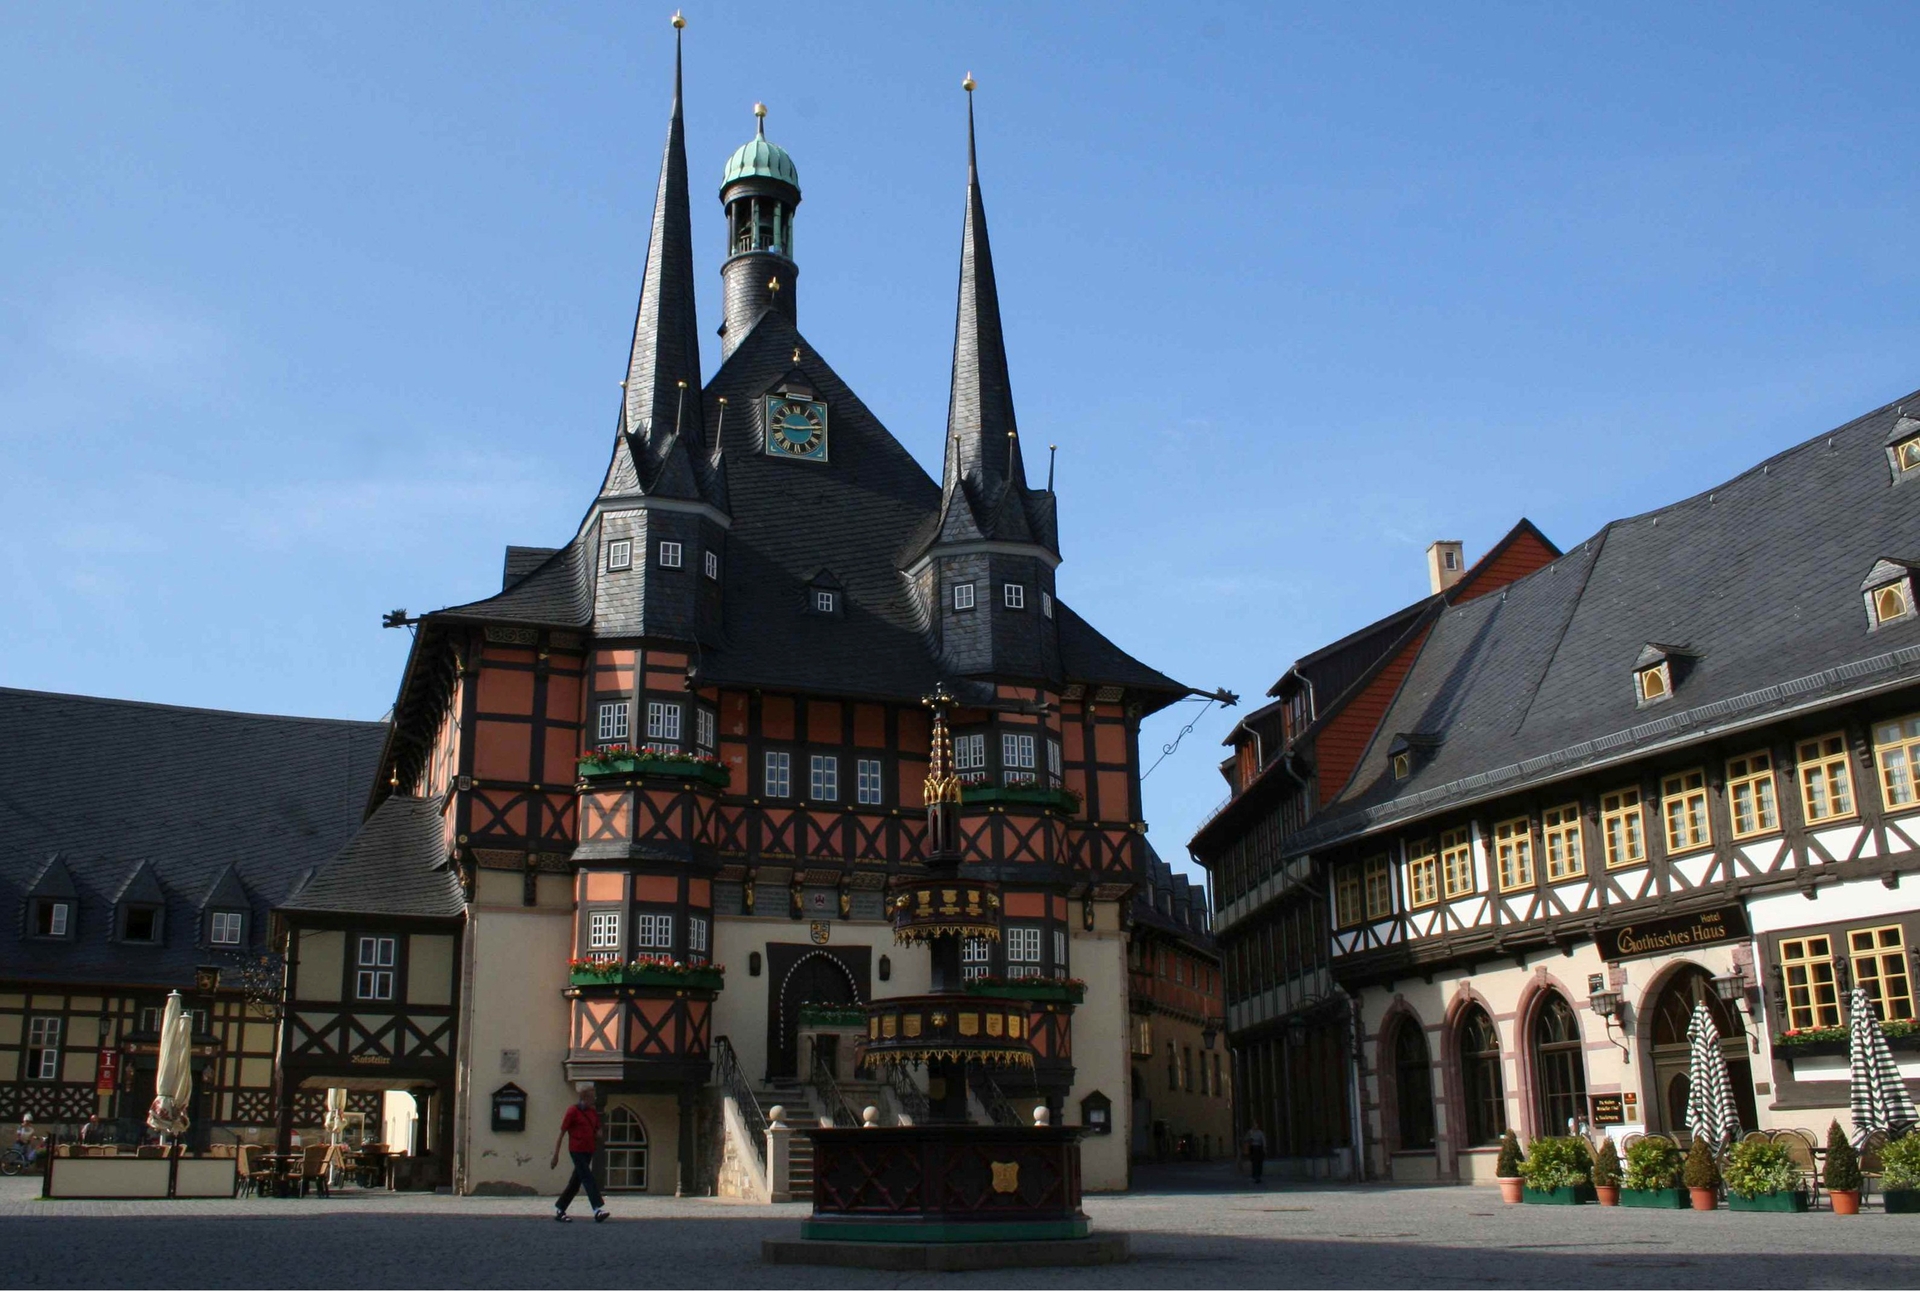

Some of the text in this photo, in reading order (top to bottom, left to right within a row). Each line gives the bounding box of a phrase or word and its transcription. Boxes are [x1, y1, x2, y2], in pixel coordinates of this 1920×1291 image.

[1700, 912, 1721, 923] Hotel
[1617, 924, 1725, 953] Gothisches Haus
